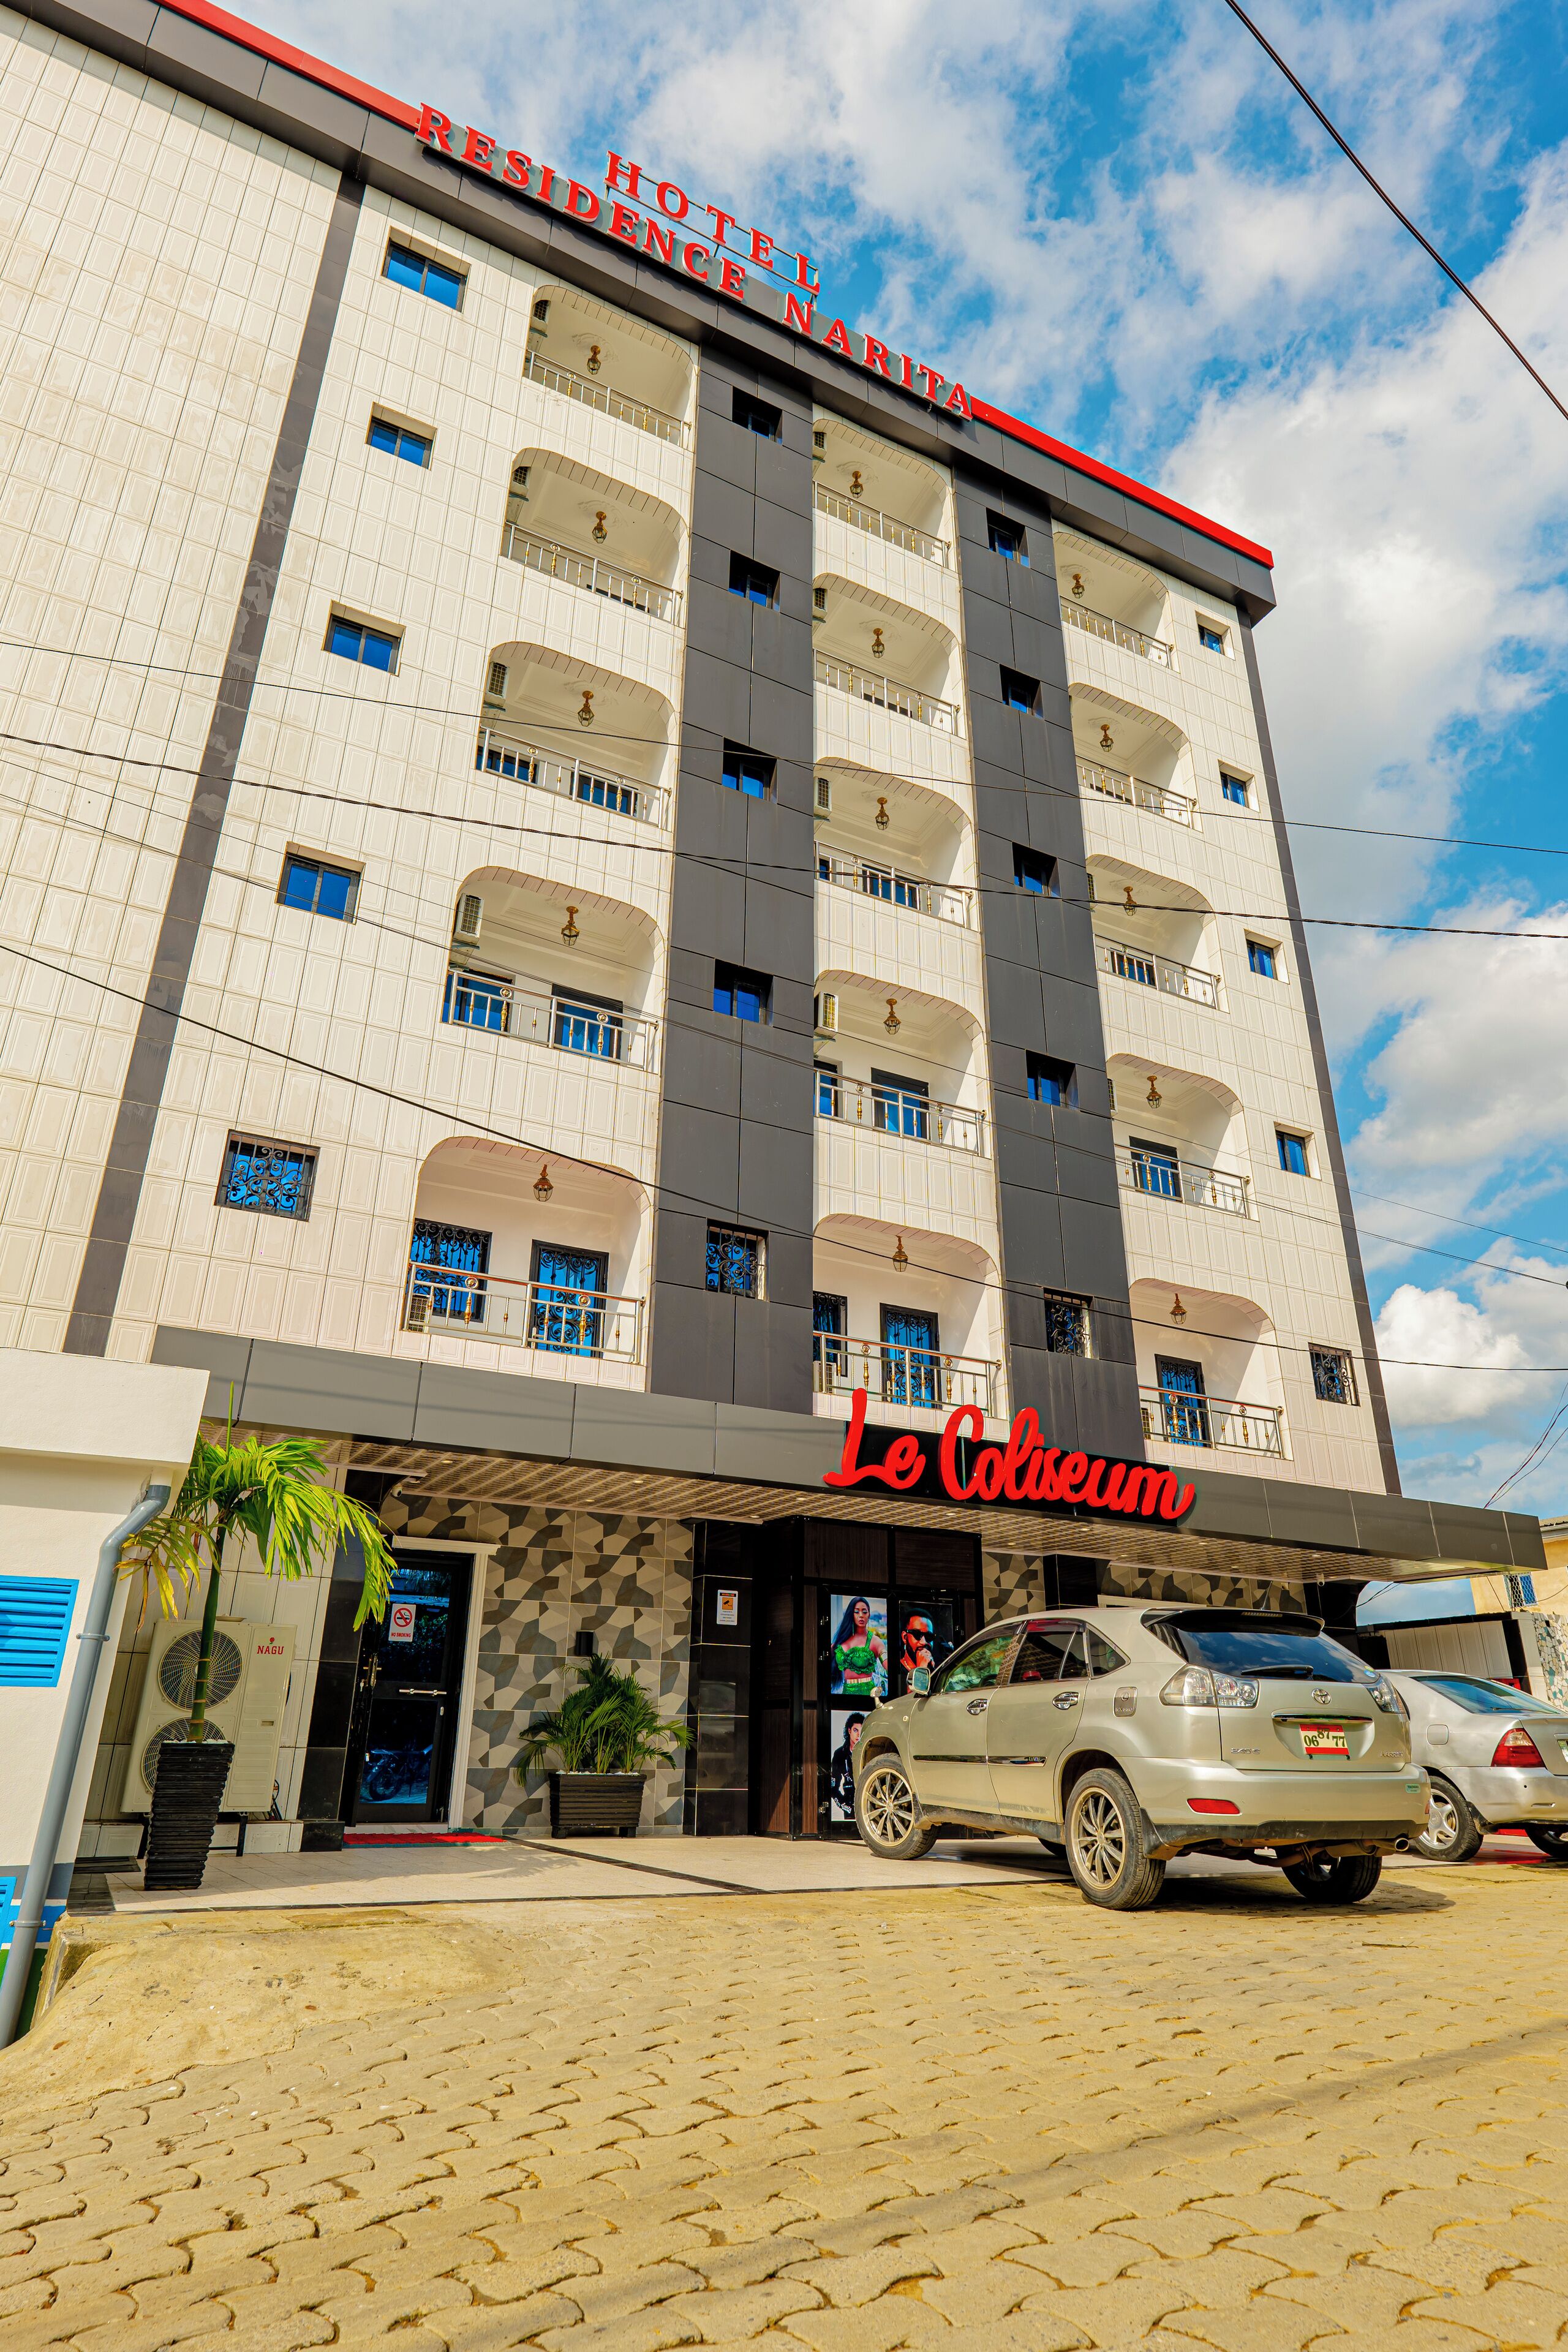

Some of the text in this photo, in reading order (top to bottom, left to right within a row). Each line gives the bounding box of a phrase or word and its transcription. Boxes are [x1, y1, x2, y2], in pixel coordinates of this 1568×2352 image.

[414, 102, 993, 423] RESIDENCE NARITA
[604, 150, 821, 296] HOTEL
[823, 1387, 1196, 1520] Le Coliseum
[257, 1645, 284, 1655] NAGU
[1303, 1727, 1345, 1747] 06 87 77
